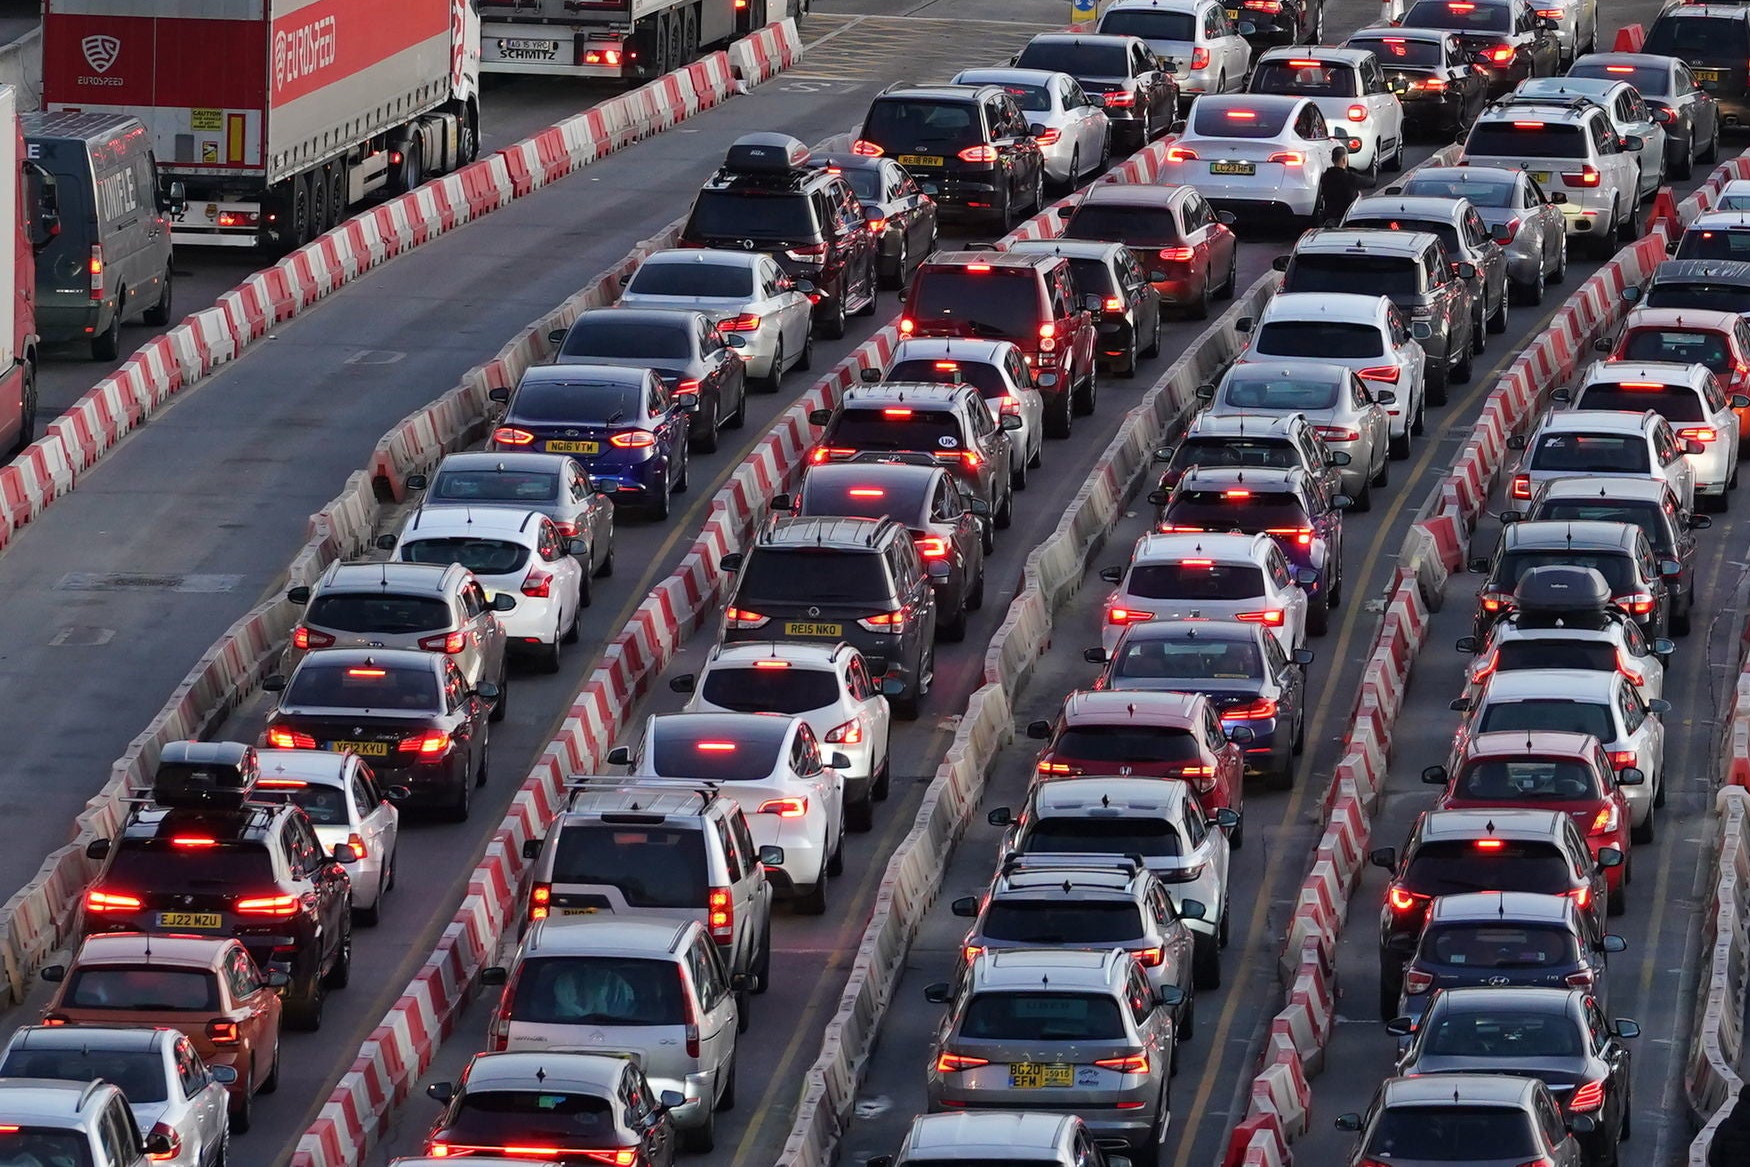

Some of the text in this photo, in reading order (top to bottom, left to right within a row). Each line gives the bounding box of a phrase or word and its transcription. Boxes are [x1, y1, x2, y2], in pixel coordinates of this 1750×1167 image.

[286, 15, 336, 83] EUROSPEED
[500, 49, 555, 60] SCHMITZ
[77, 76, 124, 86] EUROSPEED
[551, 442, 573, 452] NG16
[941, 438, 954, 446] UK
[791, 624, 813, 634] RE15
[362, 743, 384, 754] KYU
[160, 915, 217, 926] EJ22 MZU
[1010, 1064, 1041, 1075] BG20
[1013, 1076, 1037, 1087] EFM
